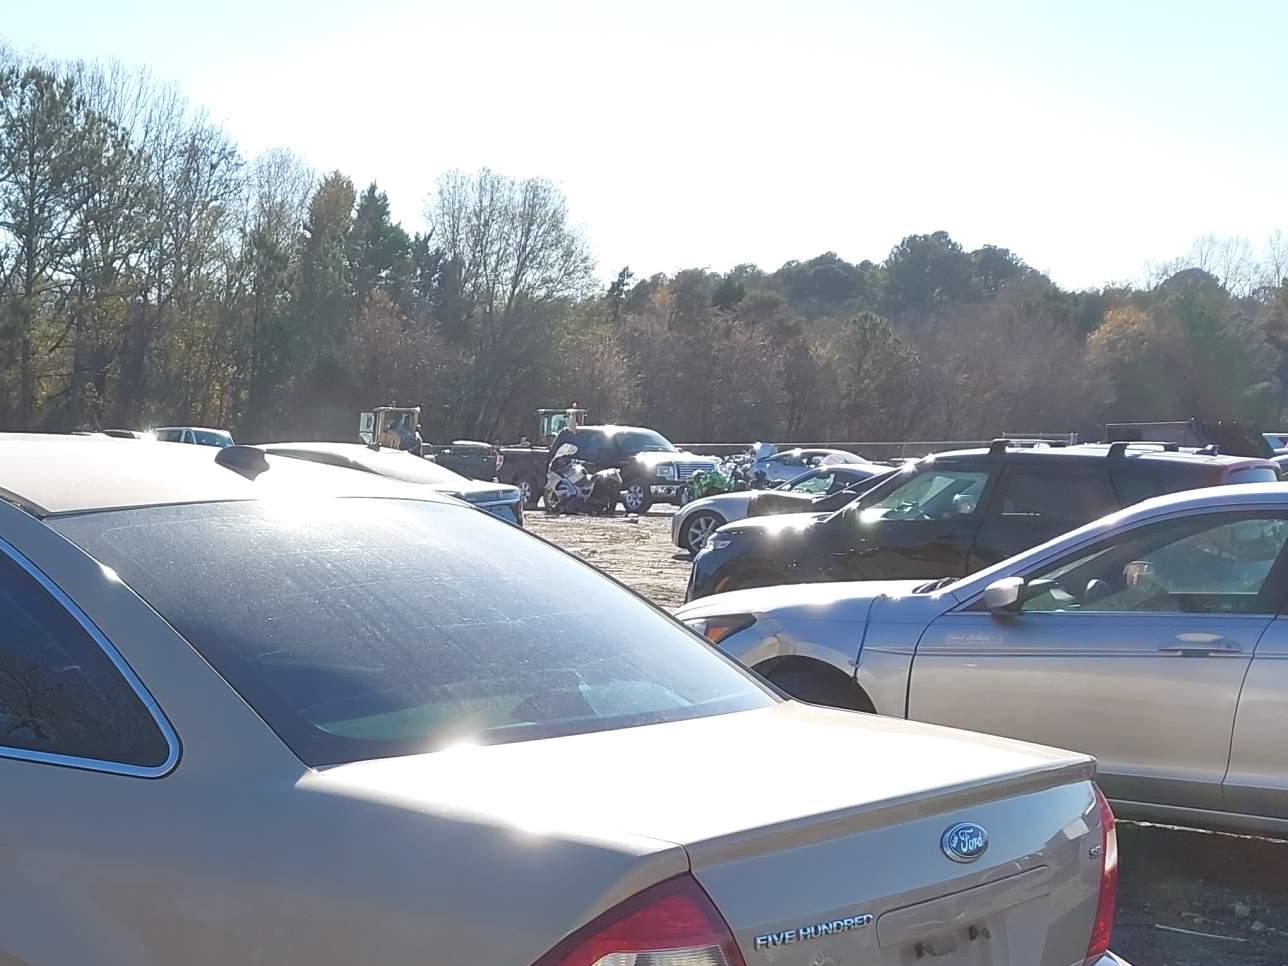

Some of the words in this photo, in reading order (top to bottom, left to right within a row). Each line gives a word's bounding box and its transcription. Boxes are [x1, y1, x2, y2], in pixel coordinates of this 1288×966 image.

[958, 828, 984, 852] Ford
[754, 930, 796, 951] FIVE
[798, 913, 873, 941] HUNDRED
